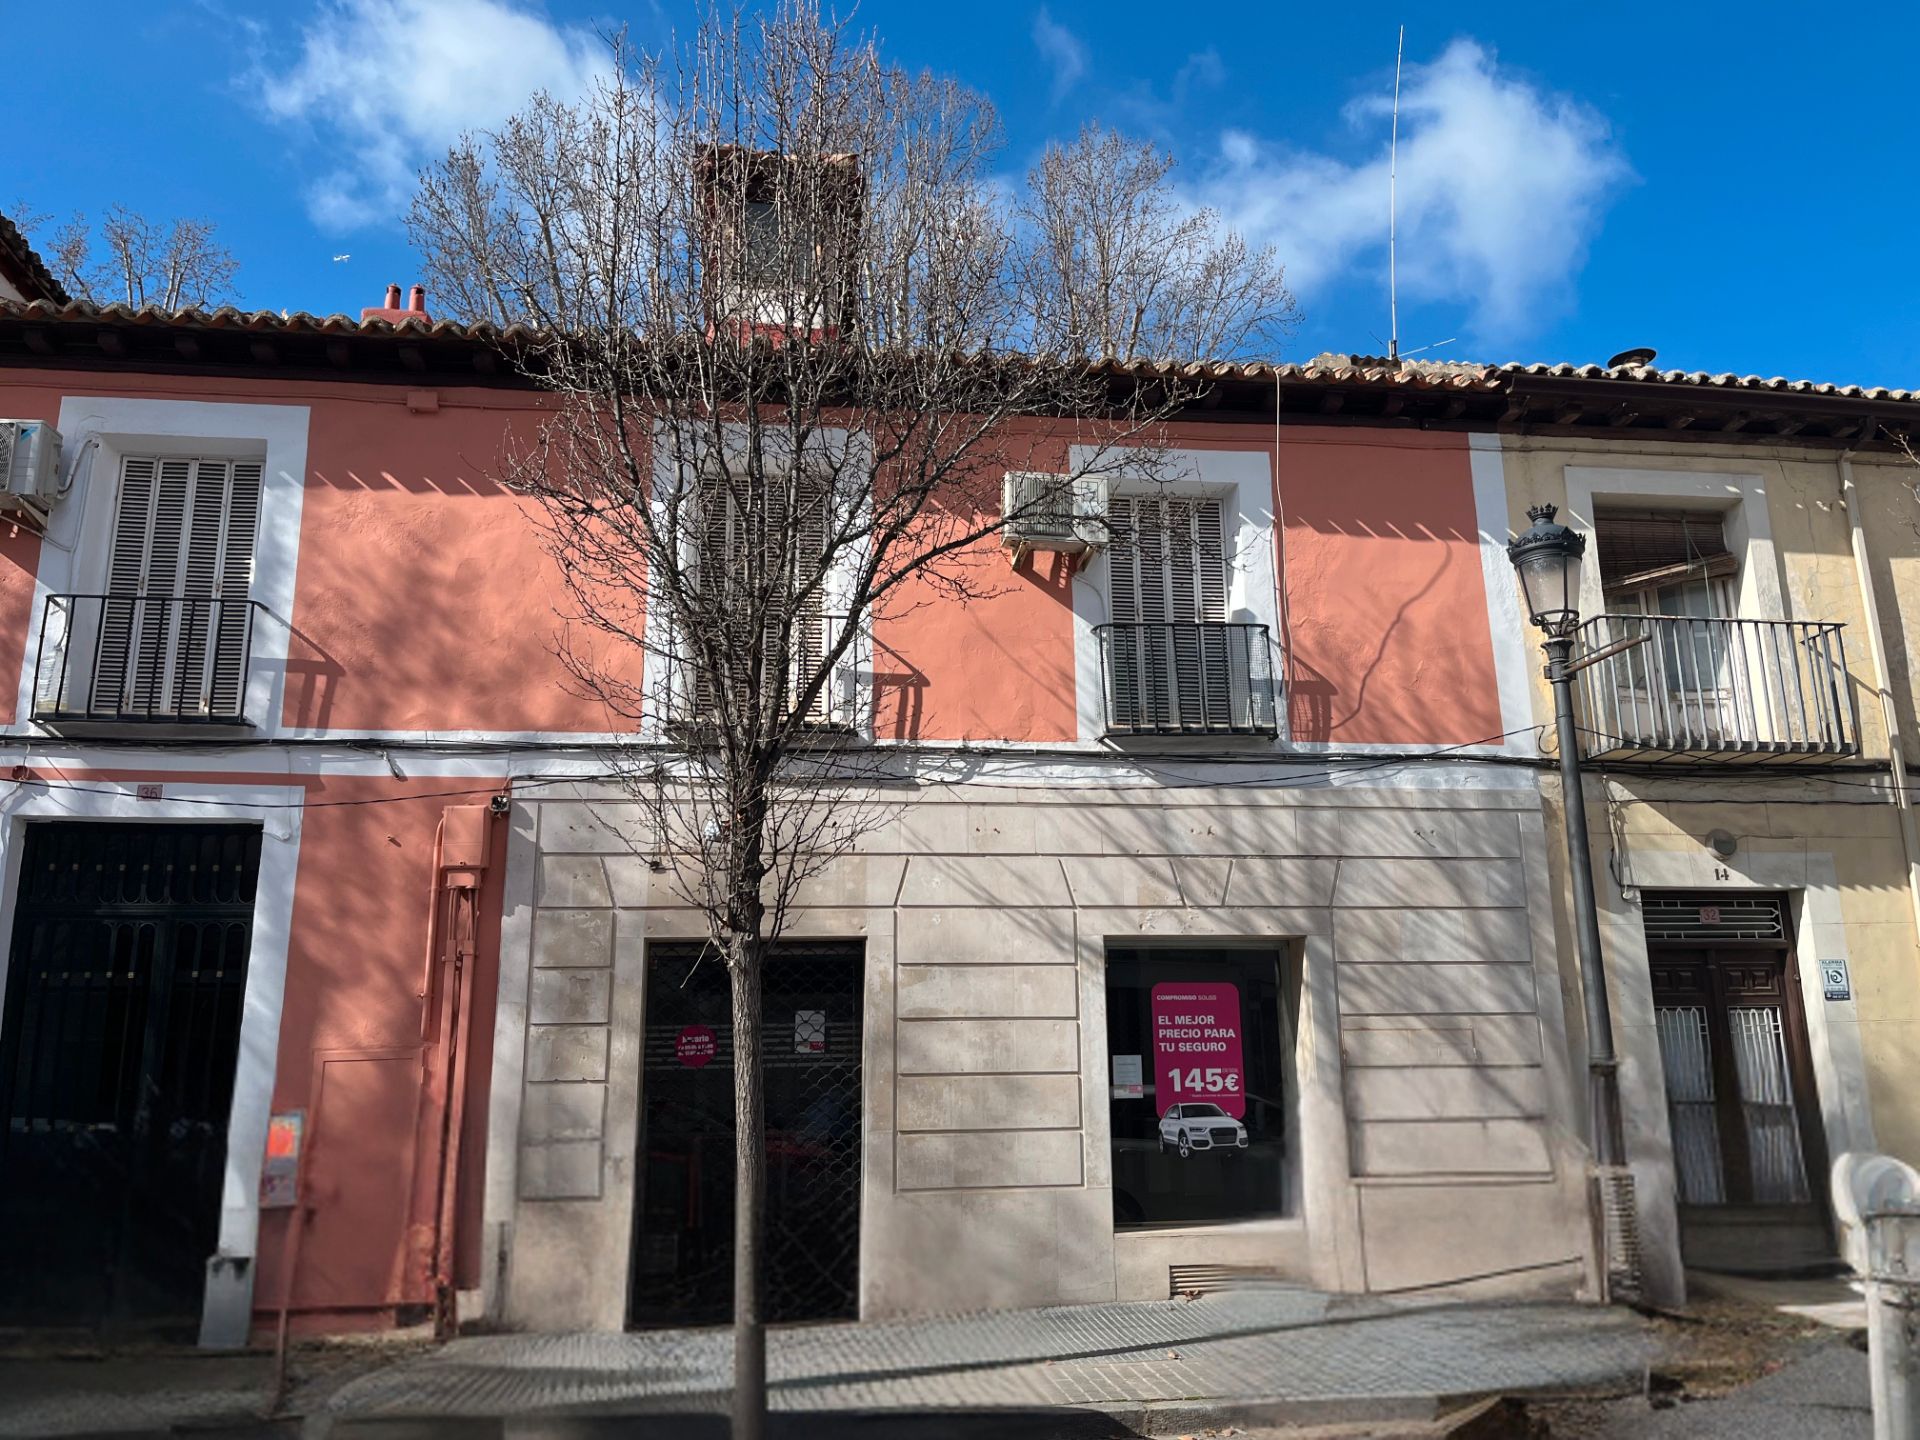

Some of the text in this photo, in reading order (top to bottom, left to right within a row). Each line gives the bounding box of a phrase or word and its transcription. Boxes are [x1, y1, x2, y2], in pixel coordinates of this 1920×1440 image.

[142, 787, 158, 799] 36
[1714, 868, 1730, 881] 14
[1703, 909, 1718, 921] 32
[1158, 1015, 1215, 1025] EL MEJOR
[1159, 1028, 1236, 1038] PRECIO PARA
[1159, 1042, 1227, 1052] TU SEGURO
[1168, 1068, 1239, 1092] 145€
